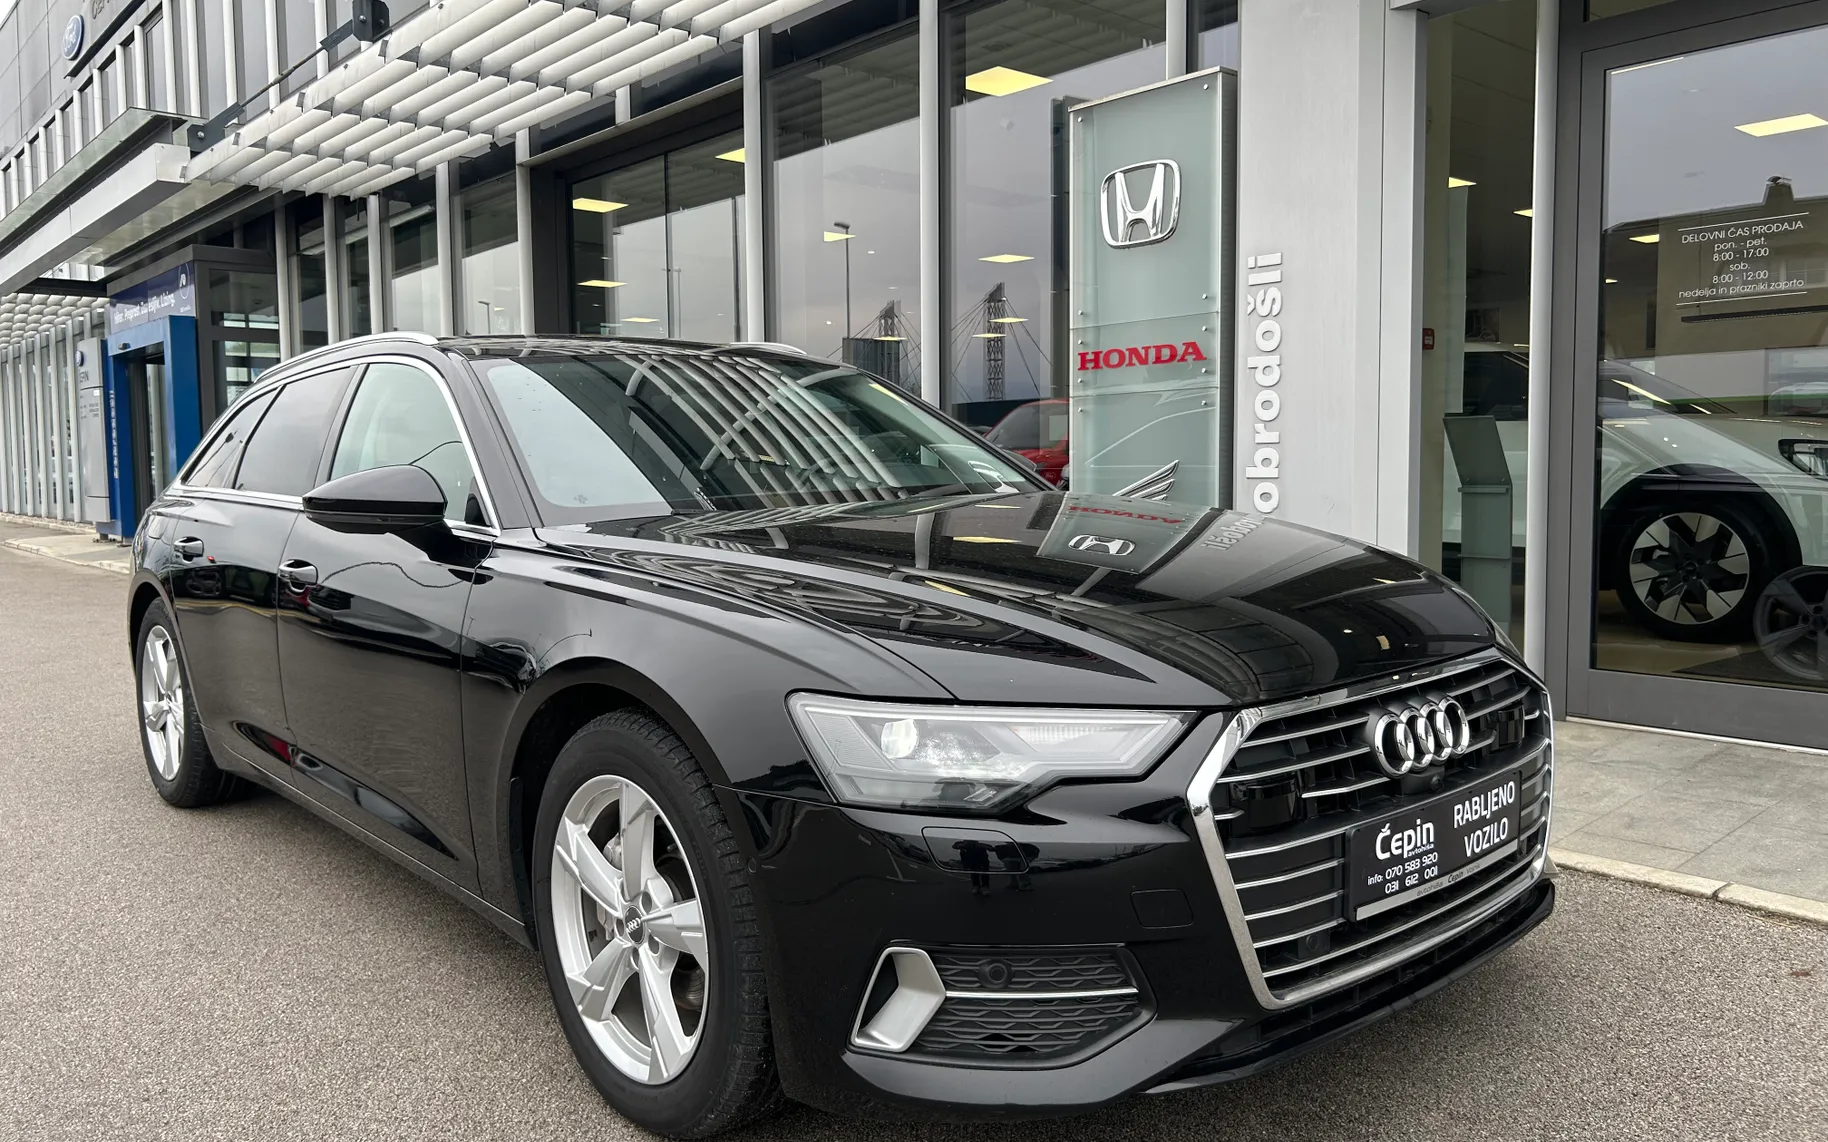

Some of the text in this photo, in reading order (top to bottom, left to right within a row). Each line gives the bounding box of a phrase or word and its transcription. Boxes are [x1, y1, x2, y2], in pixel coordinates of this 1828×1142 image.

[1681, 220, 1804, 244] DELOVNI ČAS PRODAJA
[1714, 241, 1738, 252] pon.
[1746, 237, 1767, 248] pet.
[1712, 251, 1734, 262] 8:00
[1742, 247, 1769, 259] 17:00
[1729, 262, 1751, 271] sob.
[1678, 278, 1804, 299] nedelja in prazniki zaprto
[1712, 273, 1733, 284] 8:00
[1742, 269, 1769, 281] 12:00
[1077, 341, 1208, 371] HONDA
[1246, 252, 1283, 514] obrodošli
[1453, 780, 1516, 829] RABLJENO
[1375, 818, 1435, 860] Čepin
[1463, 817, 1509, 857] VOZILO
[1367, 852, 1438, 886] info: 070 583 920
[1384, 865, 1438, 894] 031 612 001
